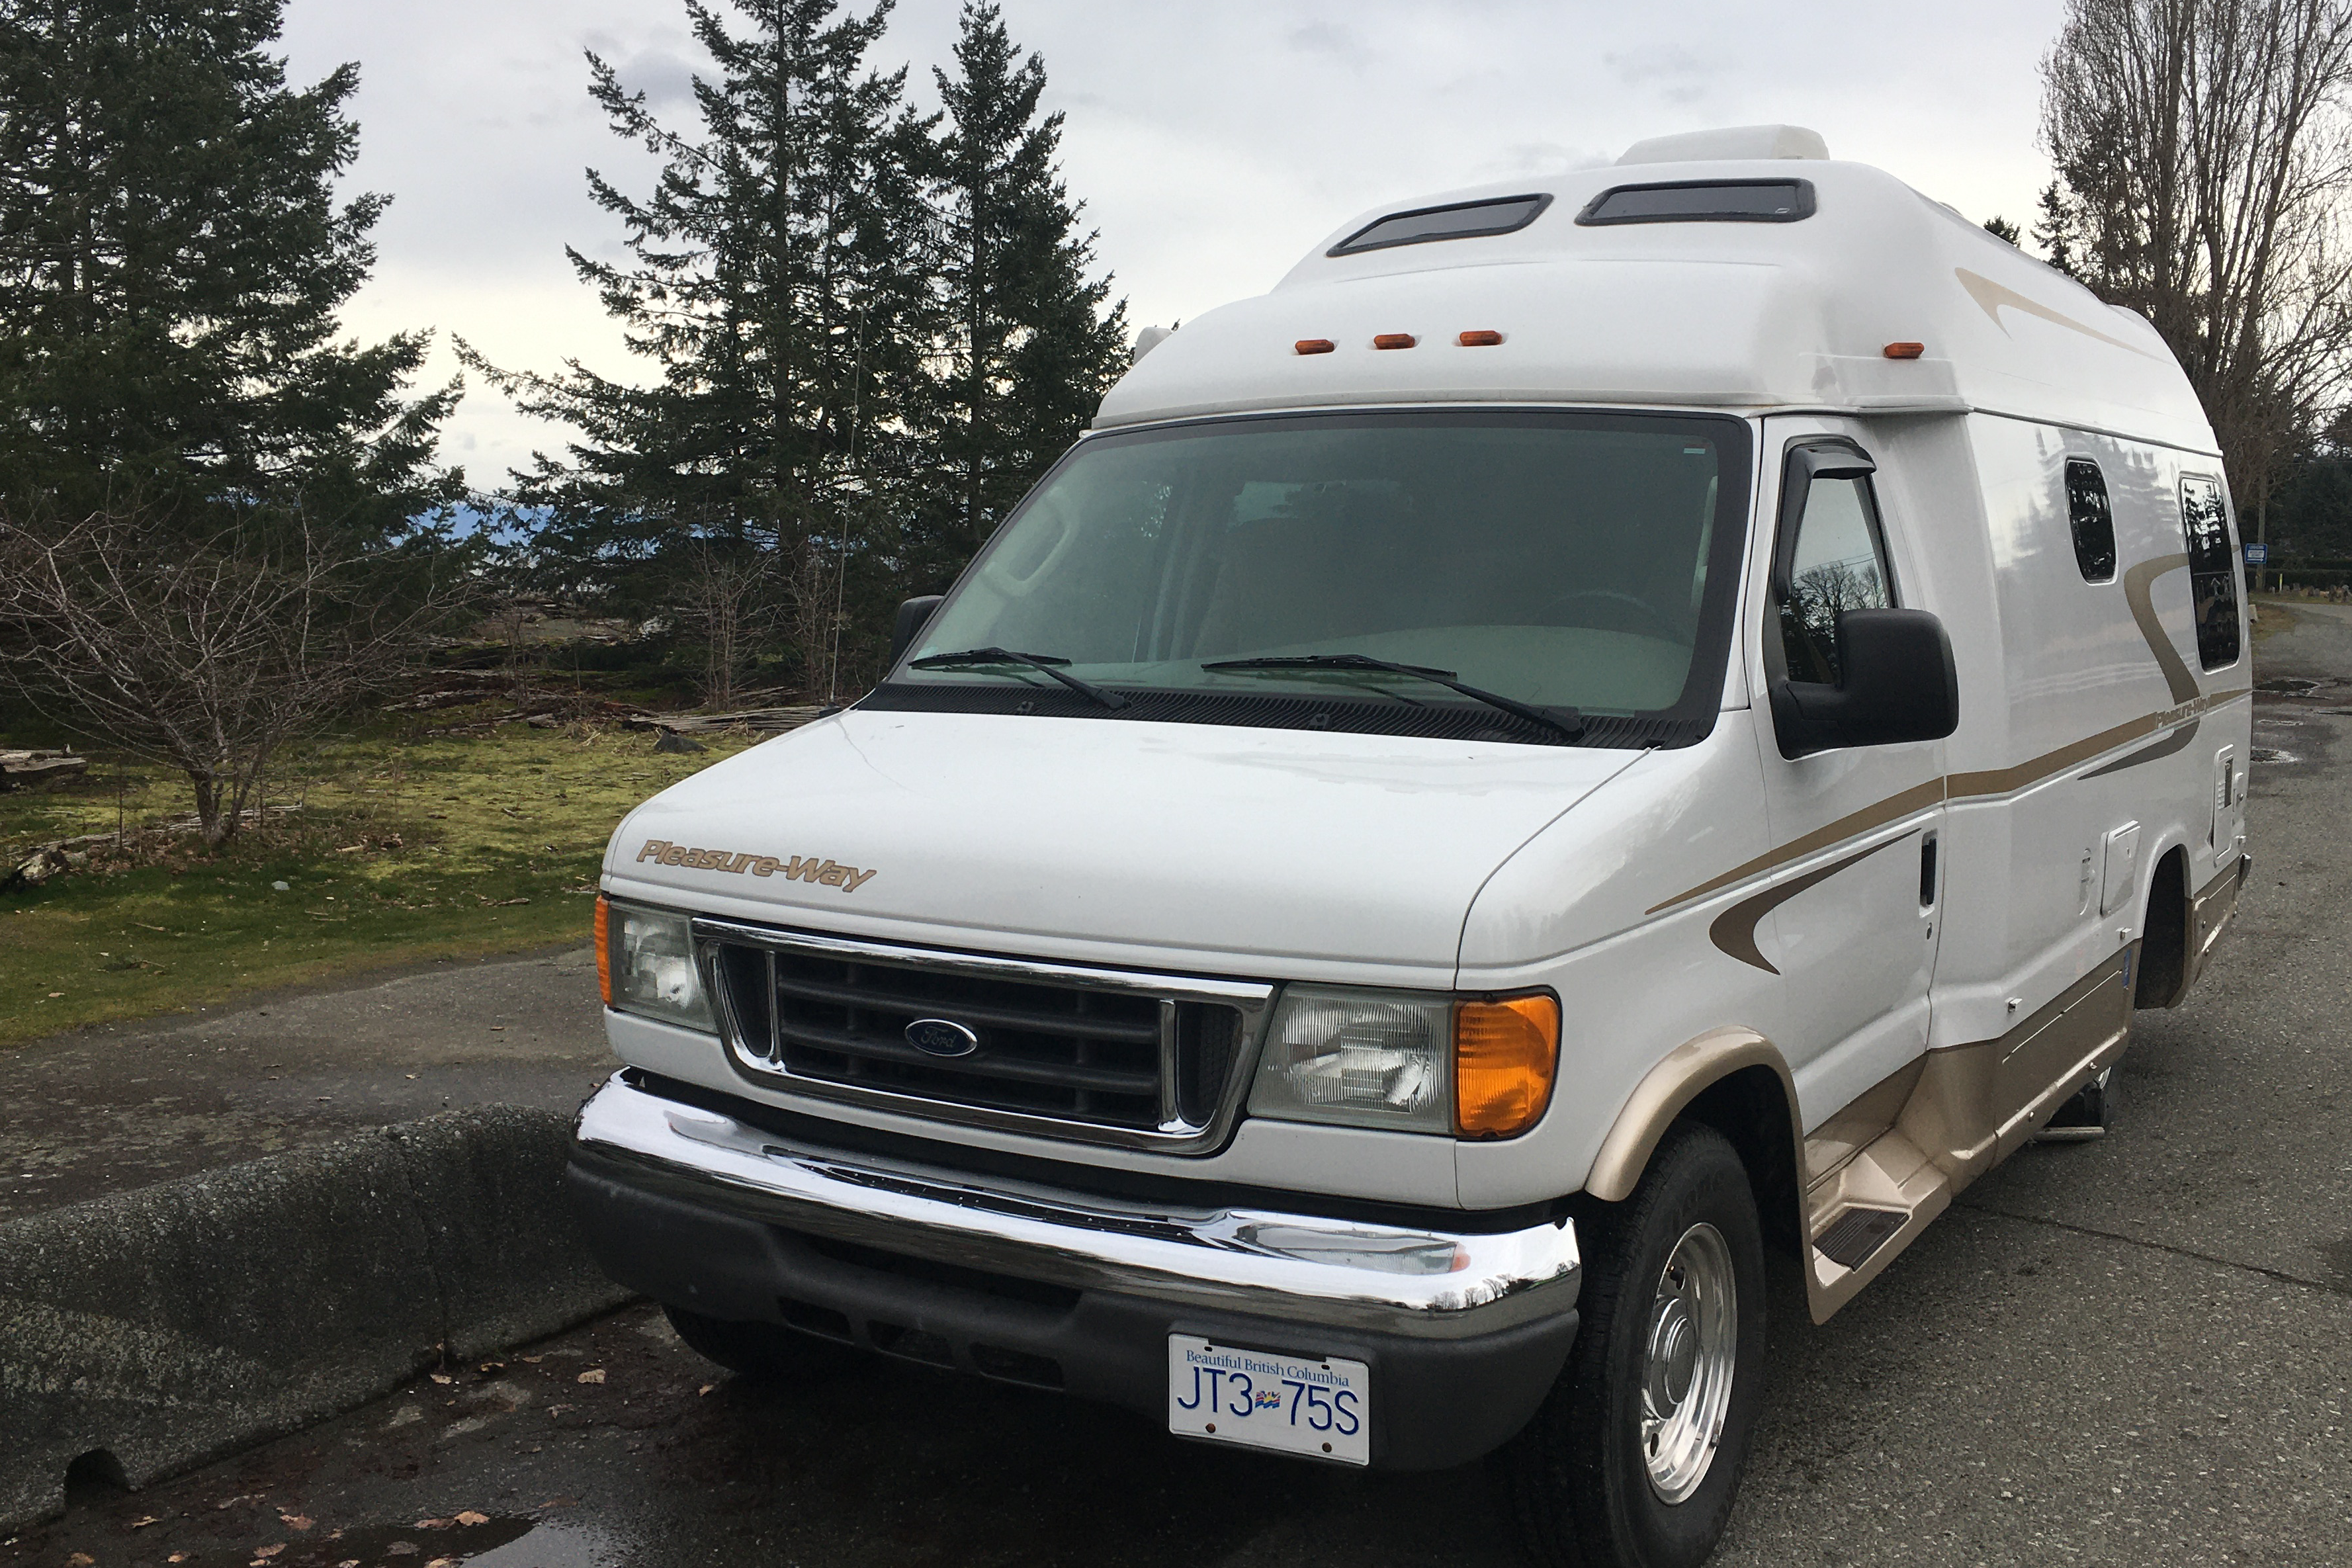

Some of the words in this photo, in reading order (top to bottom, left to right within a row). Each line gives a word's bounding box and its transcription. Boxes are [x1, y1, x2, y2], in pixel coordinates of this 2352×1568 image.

[636, 840, 877, 893] Pleasure-Way
[921, 1026, 957, 1047] Ford
[1186, 1350, 1241, 1370] Beautiful
[1245, 1358, 1284, 1376] British
[1287, 1366, 1349, 1387] Columbia
[1177, 1366, 1252, 1417] JT3
[1282, 1379, 1359, 1436] 75S
